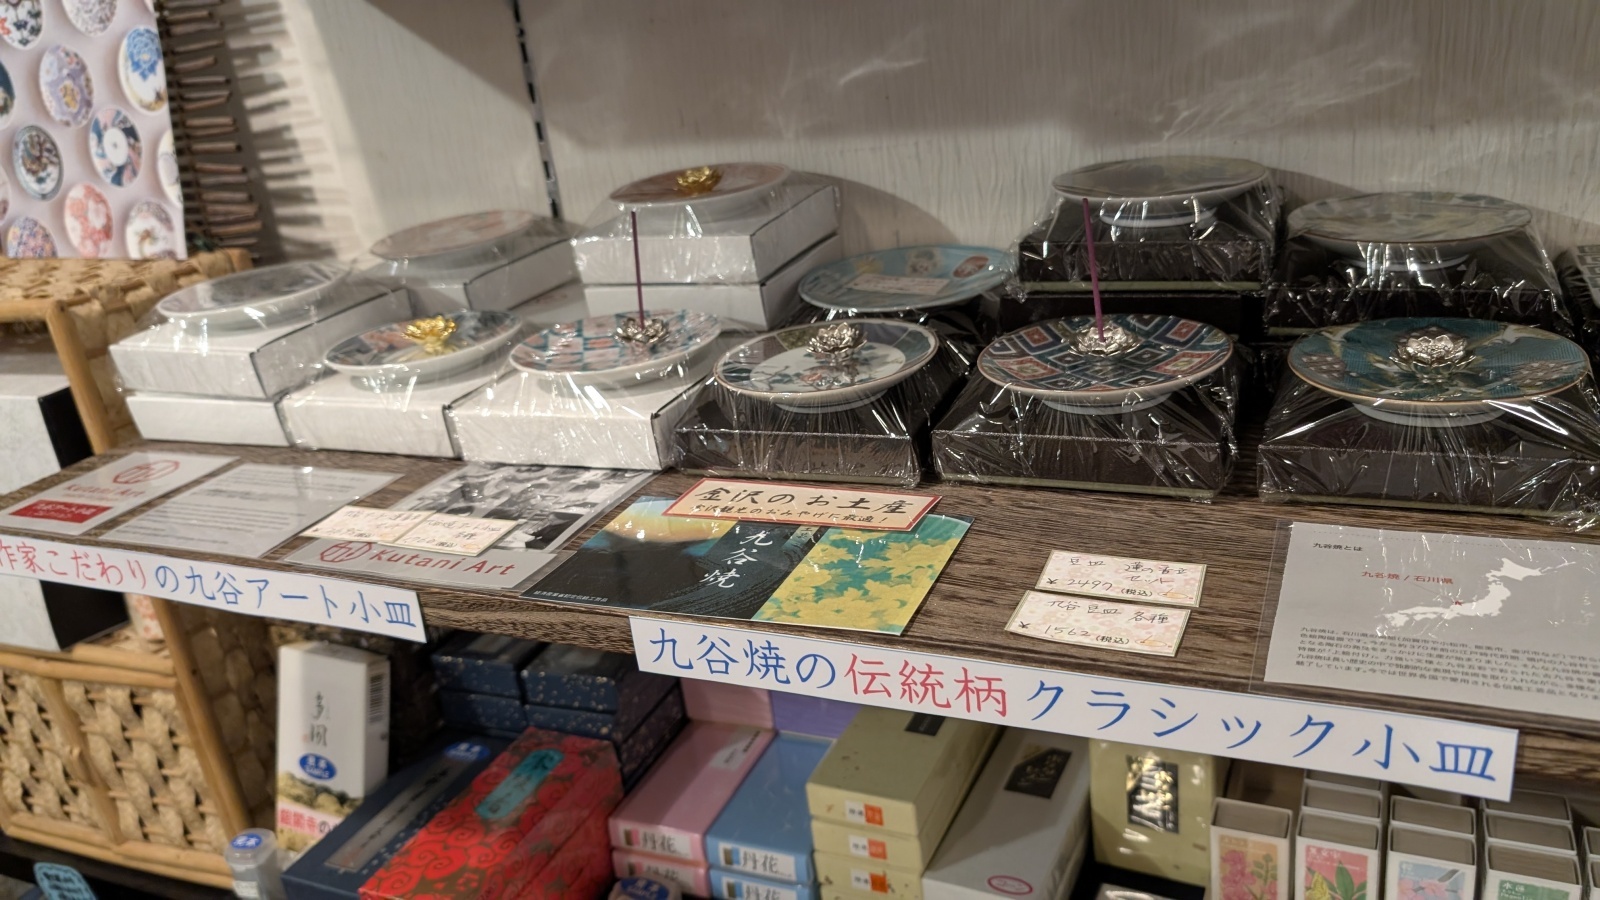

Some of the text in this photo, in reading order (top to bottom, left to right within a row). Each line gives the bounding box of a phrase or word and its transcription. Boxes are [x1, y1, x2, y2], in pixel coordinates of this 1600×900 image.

[695, 487, 913, 514] 金沢のお土産
[699, 530, 773, 588] 九谷焼
[1313, 542, 1363, 552] 九谷焼とは
[370, 550, 517, 577] Kutani Art
[1126, 575, 1175, 585] セット
[742, 850, 779, 874] 丹花
